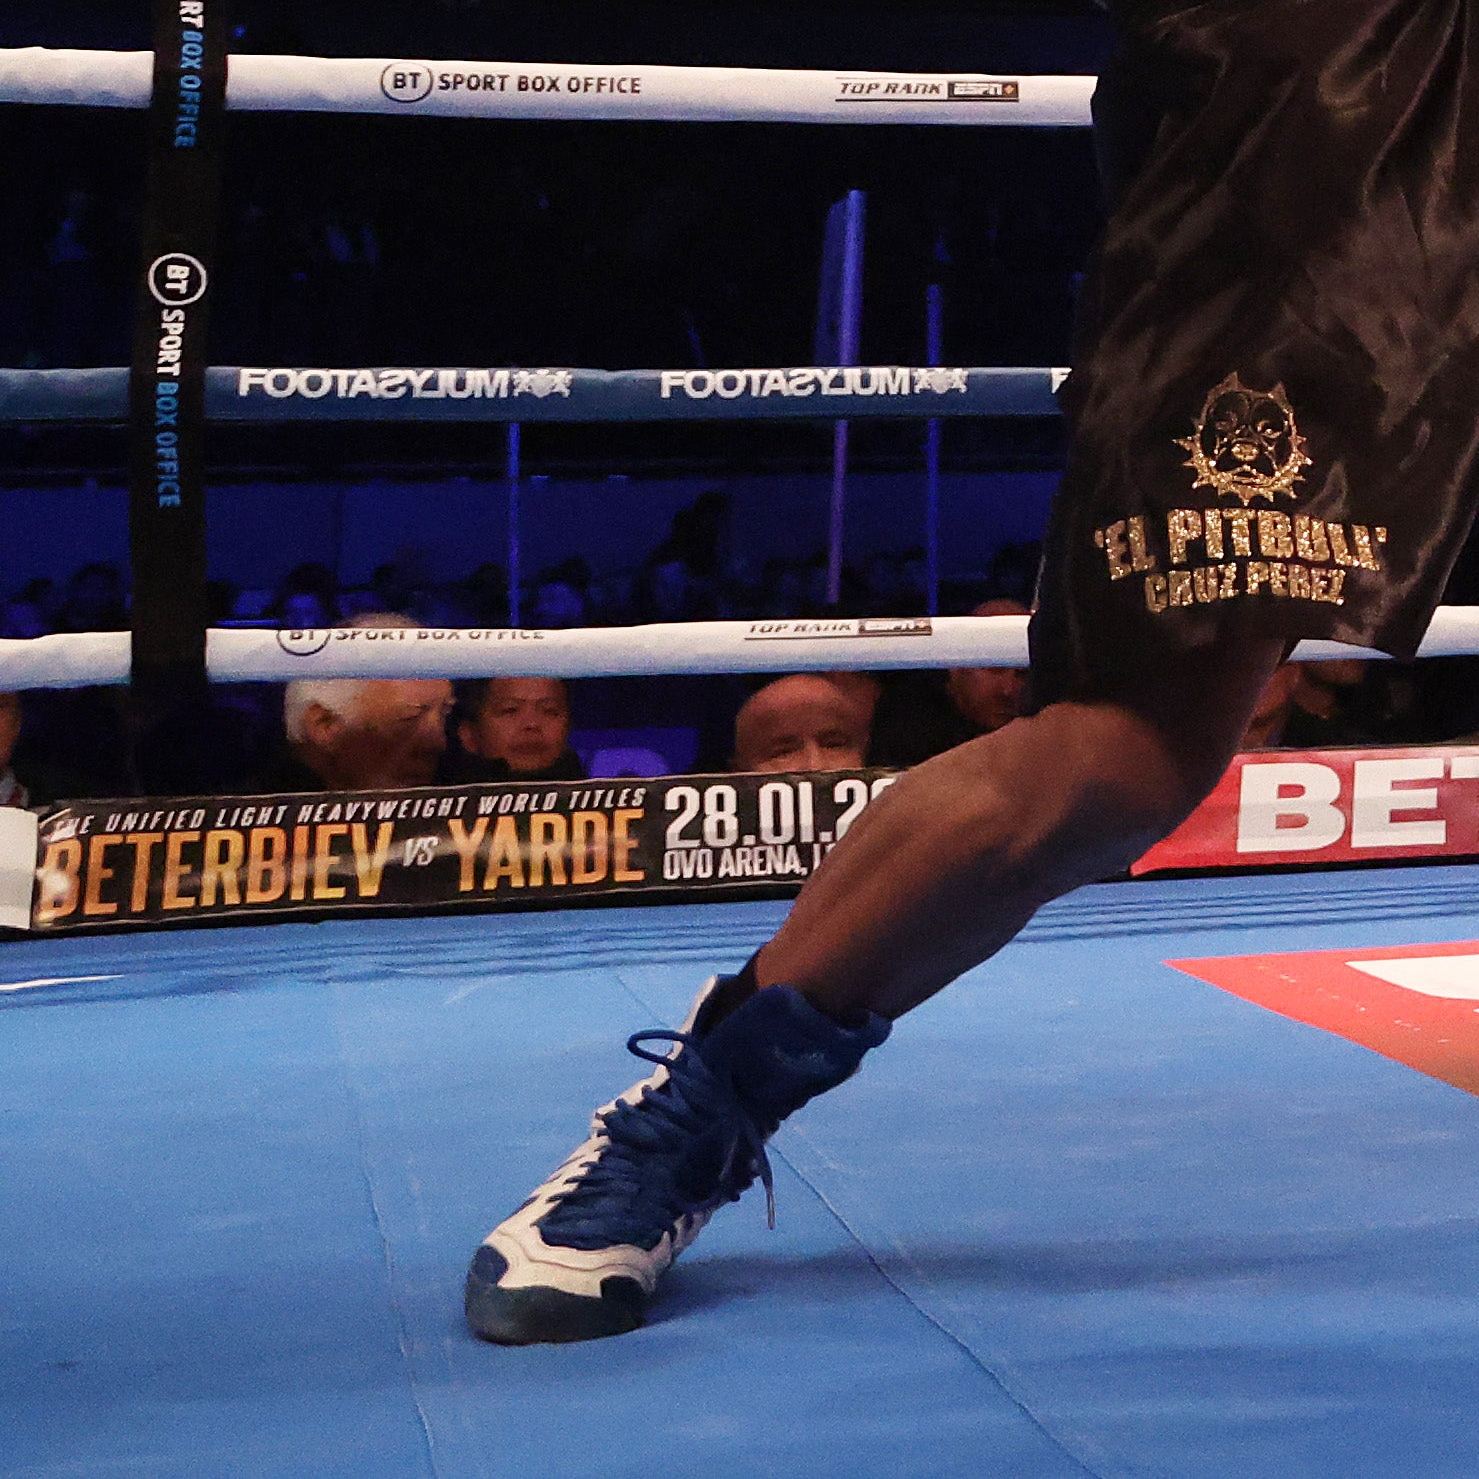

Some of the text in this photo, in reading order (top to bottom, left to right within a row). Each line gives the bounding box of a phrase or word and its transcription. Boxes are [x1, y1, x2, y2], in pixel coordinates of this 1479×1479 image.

[180, 29, 204, 70] BOX
[392, 72, 643, 96] BT SPORT BOX OFFICE
[839, 81, 879, 96] TOP
[880, 81, 943, 96] RANK
[174, 73, 204, 149] OFFICE
[155, 263, 190, 507] BT SPORT BOX OFFICE
[238, 367, 508, 400] FOOTASYLUM
[660, 367, 910, 399] FOOTASYLUM
[1144, 562, 1240, 614] CRUZ
[105, 807, 208, 834] UNIFIED
[215, 803, 290, 828] LIGHT
[297, 795, 470, 824] HEAVYWEIGHT
[476, 789, 564, 815] WORLD
[567, 785, 647, 811] TITLES
[38, 822, 393, 924] BETERBIEV
[447, 808, 648, 894] YARDE
[662, 848, 714, 882] OVO
[718, 843, 810, 880] ARENA,
